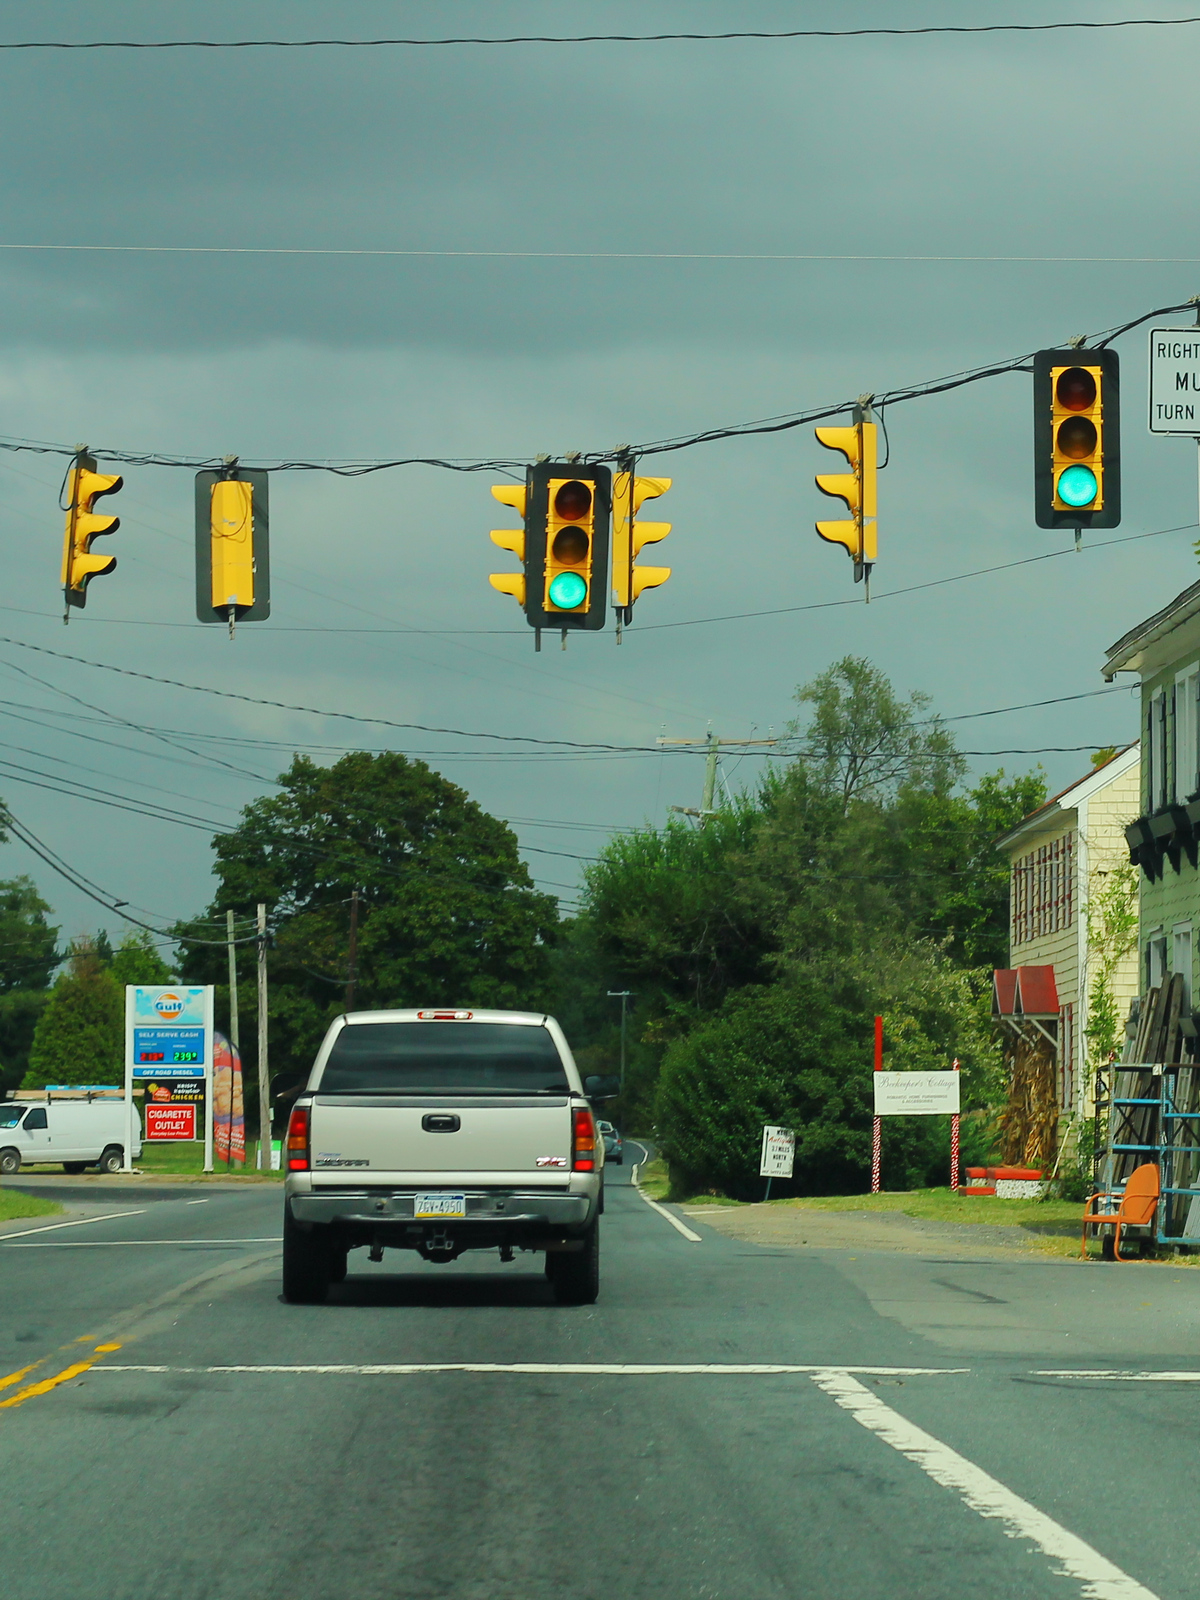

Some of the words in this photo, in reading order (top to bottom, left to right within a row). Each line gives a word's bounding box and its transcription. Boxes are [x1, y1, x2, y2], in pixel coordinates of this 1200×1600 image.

[1157, 343, 1200, 359] RIGHT
[1156, 404, 1194, 420] TURN
[155, 1002, 182, 1011] Gulf
[148, 1109, 193, 1119] CIGARETTE
[154, 1120, 186, 1131] OUTLET
